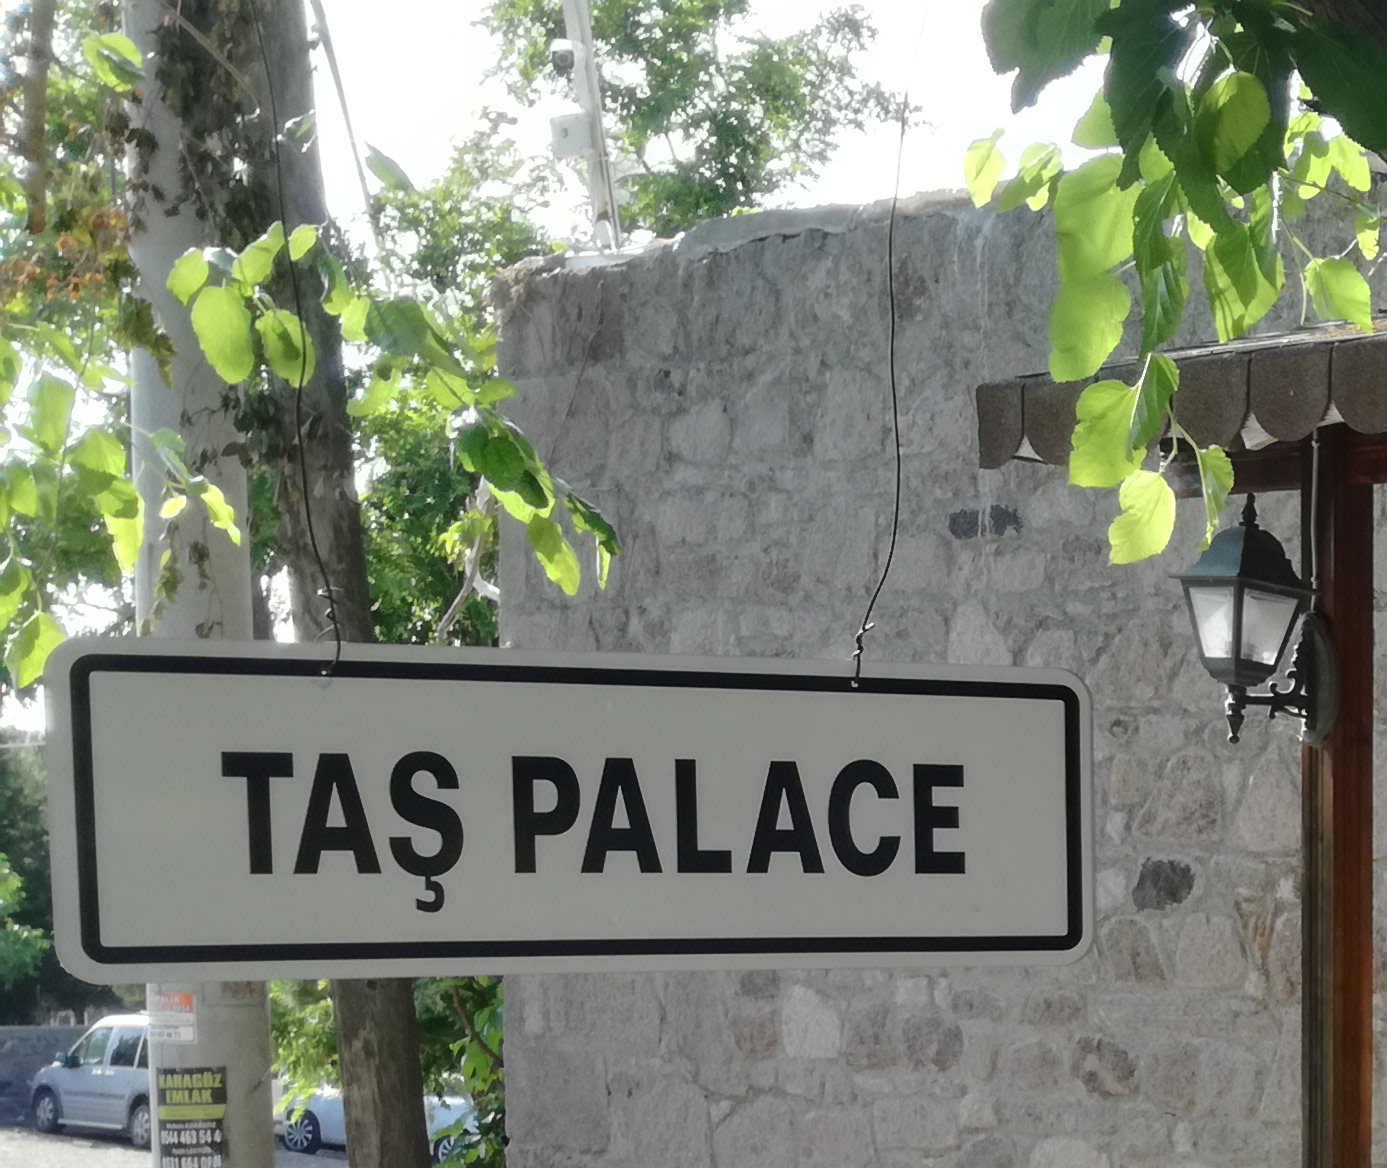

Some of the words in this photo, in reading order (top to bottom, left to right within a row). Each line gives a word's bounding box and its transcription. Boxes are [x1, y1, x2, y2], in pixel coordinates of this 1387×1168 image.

[220, 750, 465, 913] TAŞ
[511, 755, 967, 878] PALACE
[159, 1071, 222, 1088] KARAGÖZ
[166, 1089, 213, 1104] EMLAK
